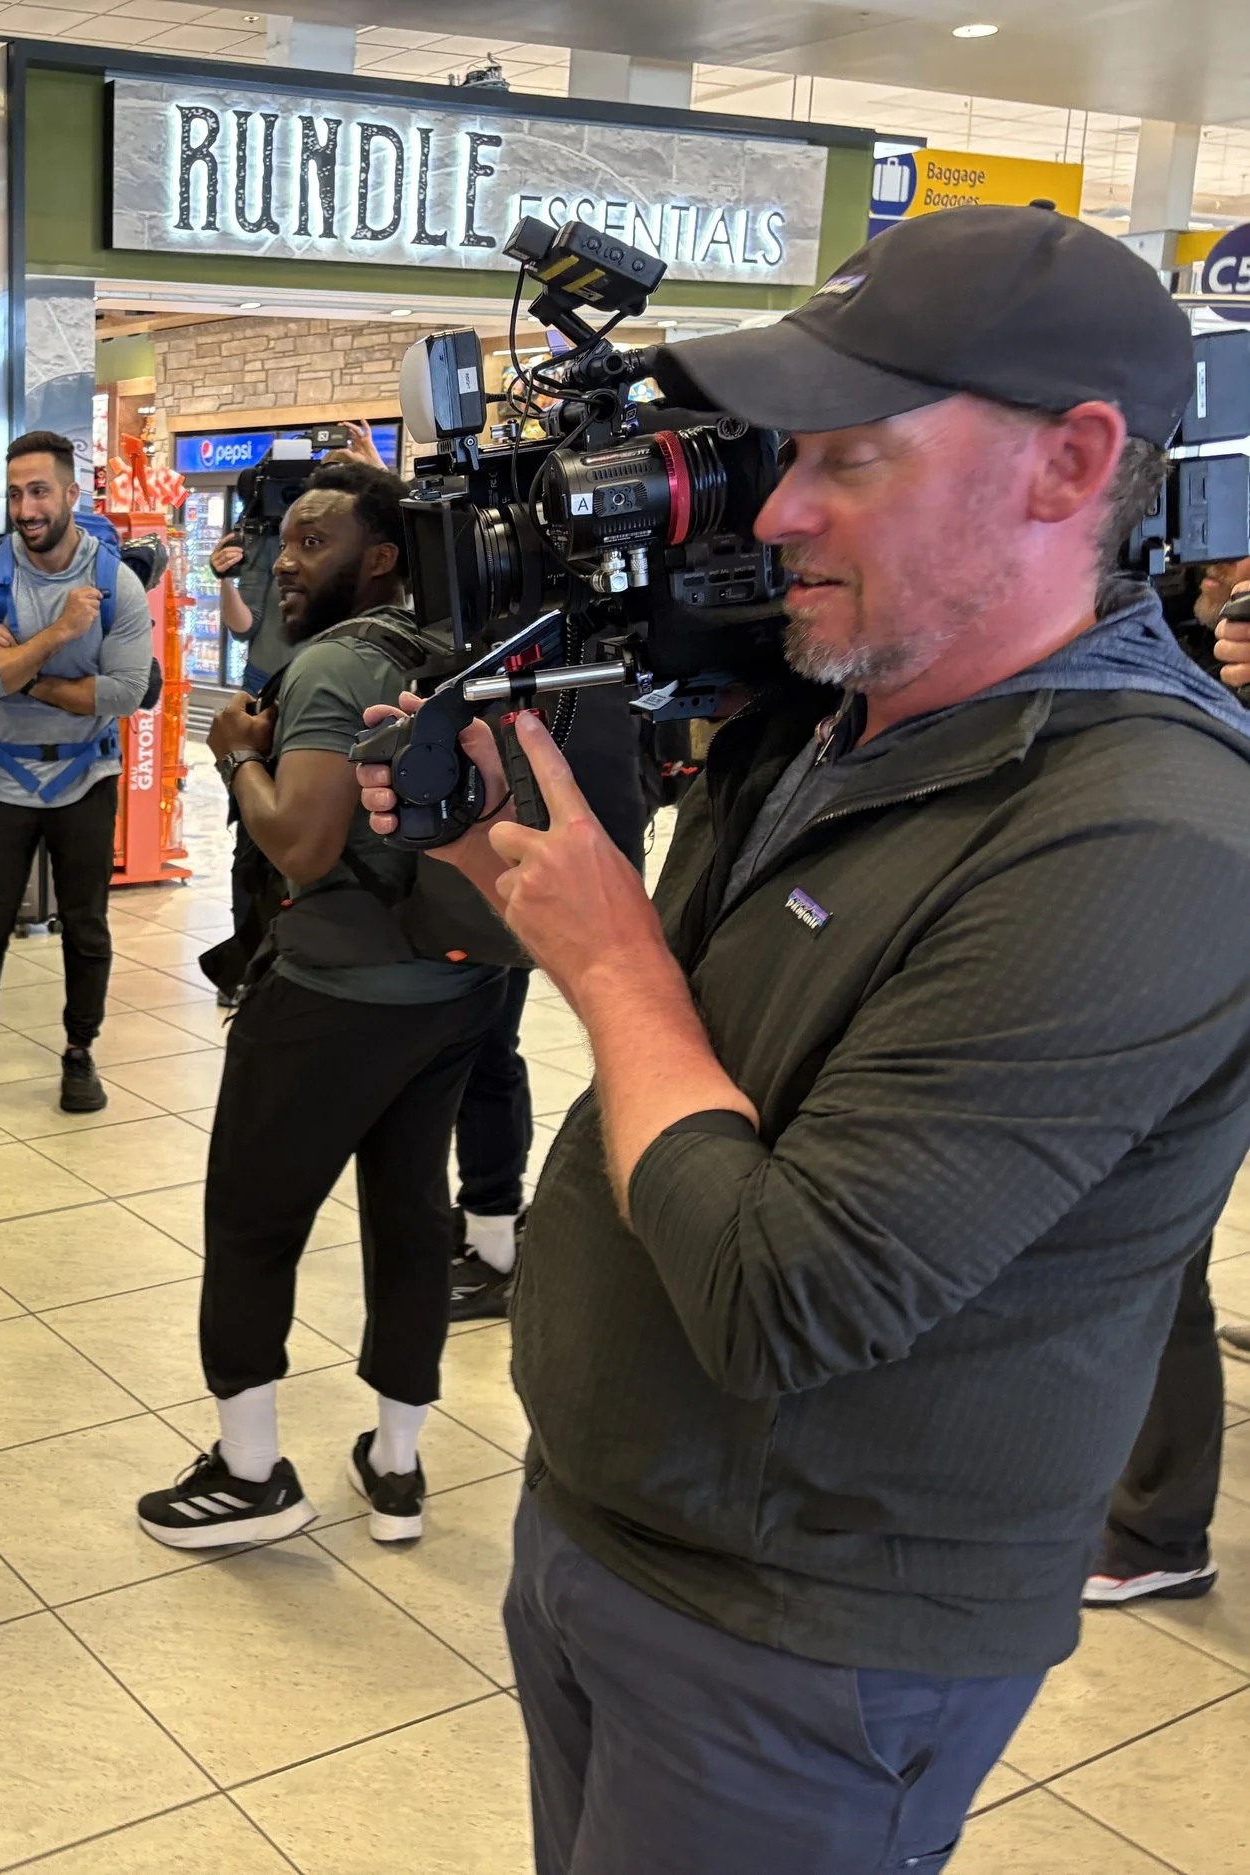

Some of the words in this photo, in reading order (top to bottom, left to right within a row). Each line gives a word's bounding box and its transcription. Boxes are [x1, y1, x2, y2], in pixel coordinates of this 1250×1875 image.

[173, 103, 503, 249] RUNDLE
[927, 161, 986, 188] Baggage
[1208, 255, 1250, 293] C5
[215, 440, 253, 466] pepsi
[577, 497, 589, 512] A
[137, 708, 154, 791] GATOR
